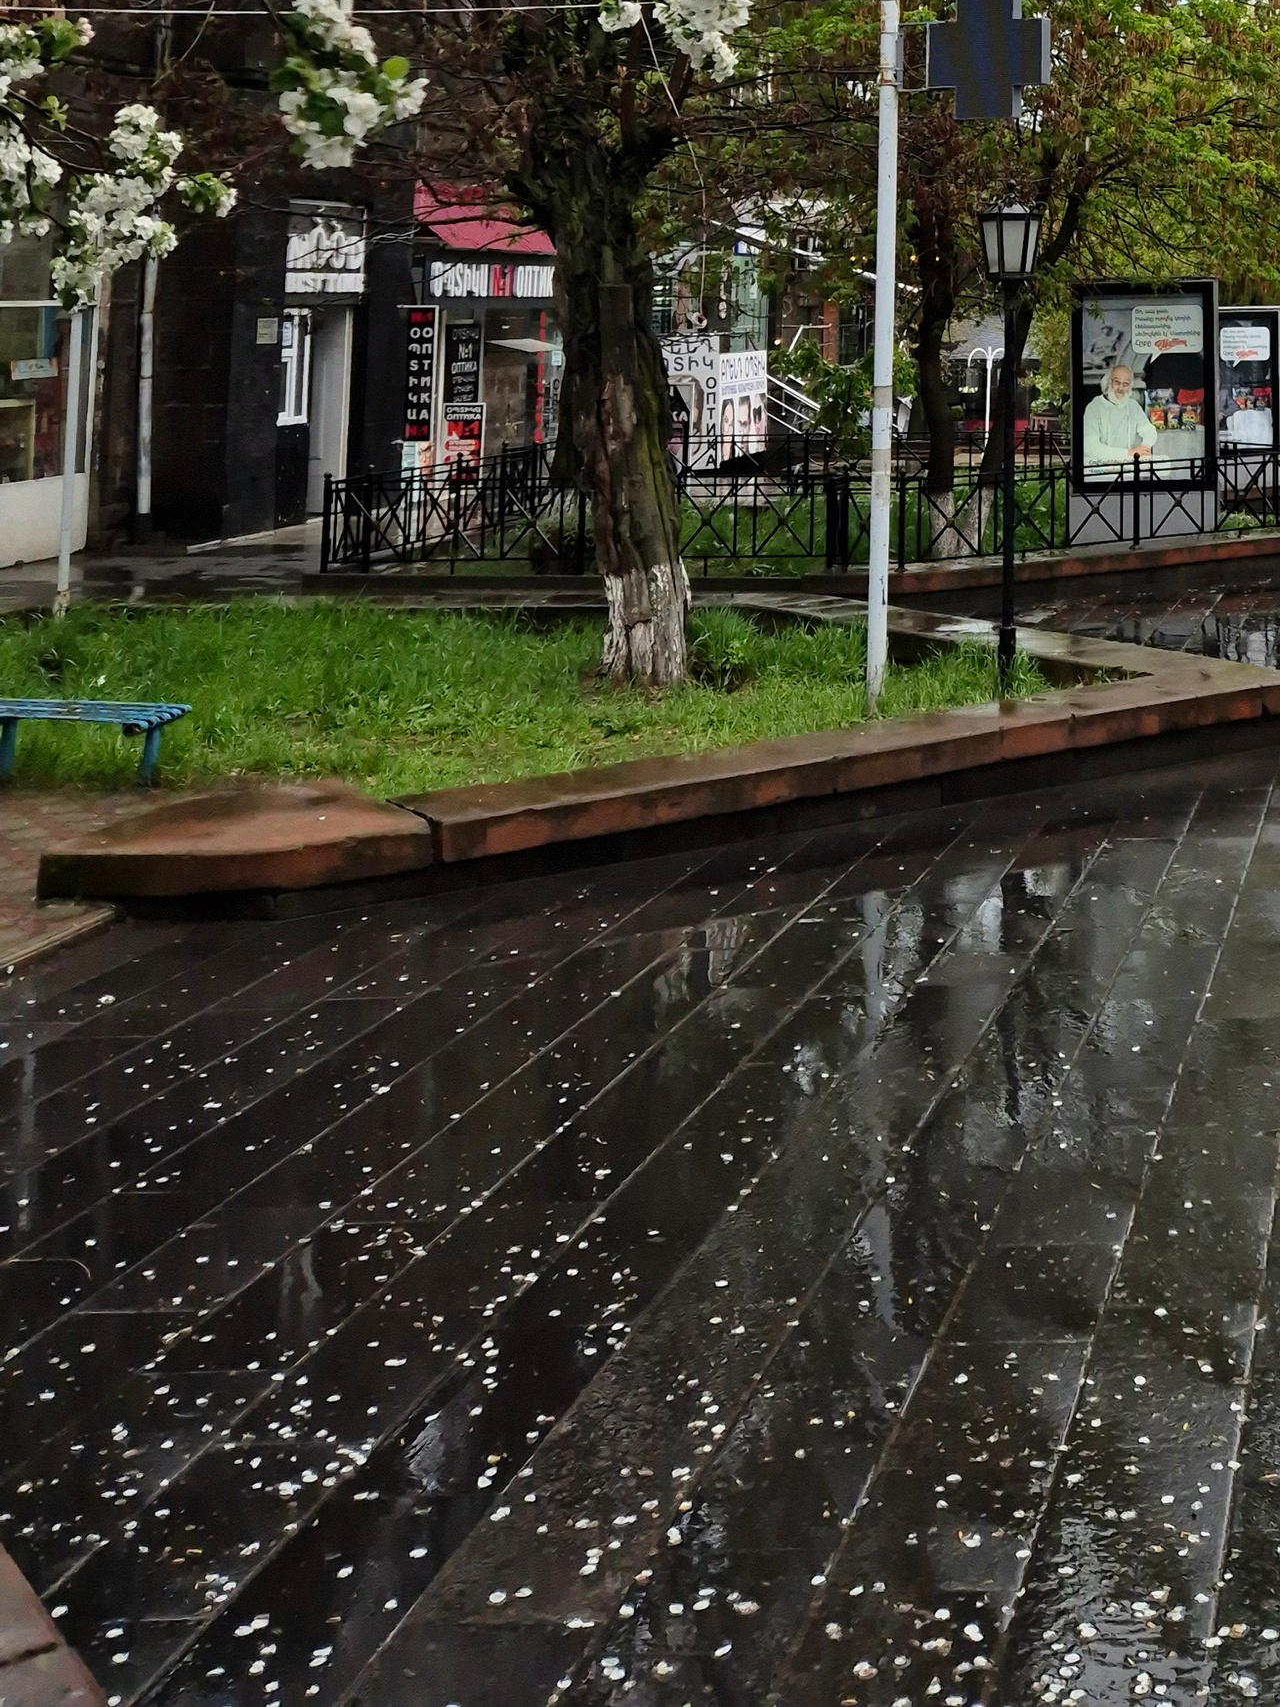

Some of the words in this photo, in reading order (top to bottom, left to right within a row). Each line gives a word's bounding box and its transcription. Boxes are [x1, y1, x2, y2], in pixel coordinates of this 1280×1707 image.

[514, 265, 555, 297] ОПТИК
[419, 327, 434, 420] ОПТИКА
[451, 360, 478, 375] ОПТИКА
[663, 355, 714, 372] ՏԻԿ
[446, 413, 482, 421] ОПТИКА
[705, 376, 717, 467] ОПТИКА
